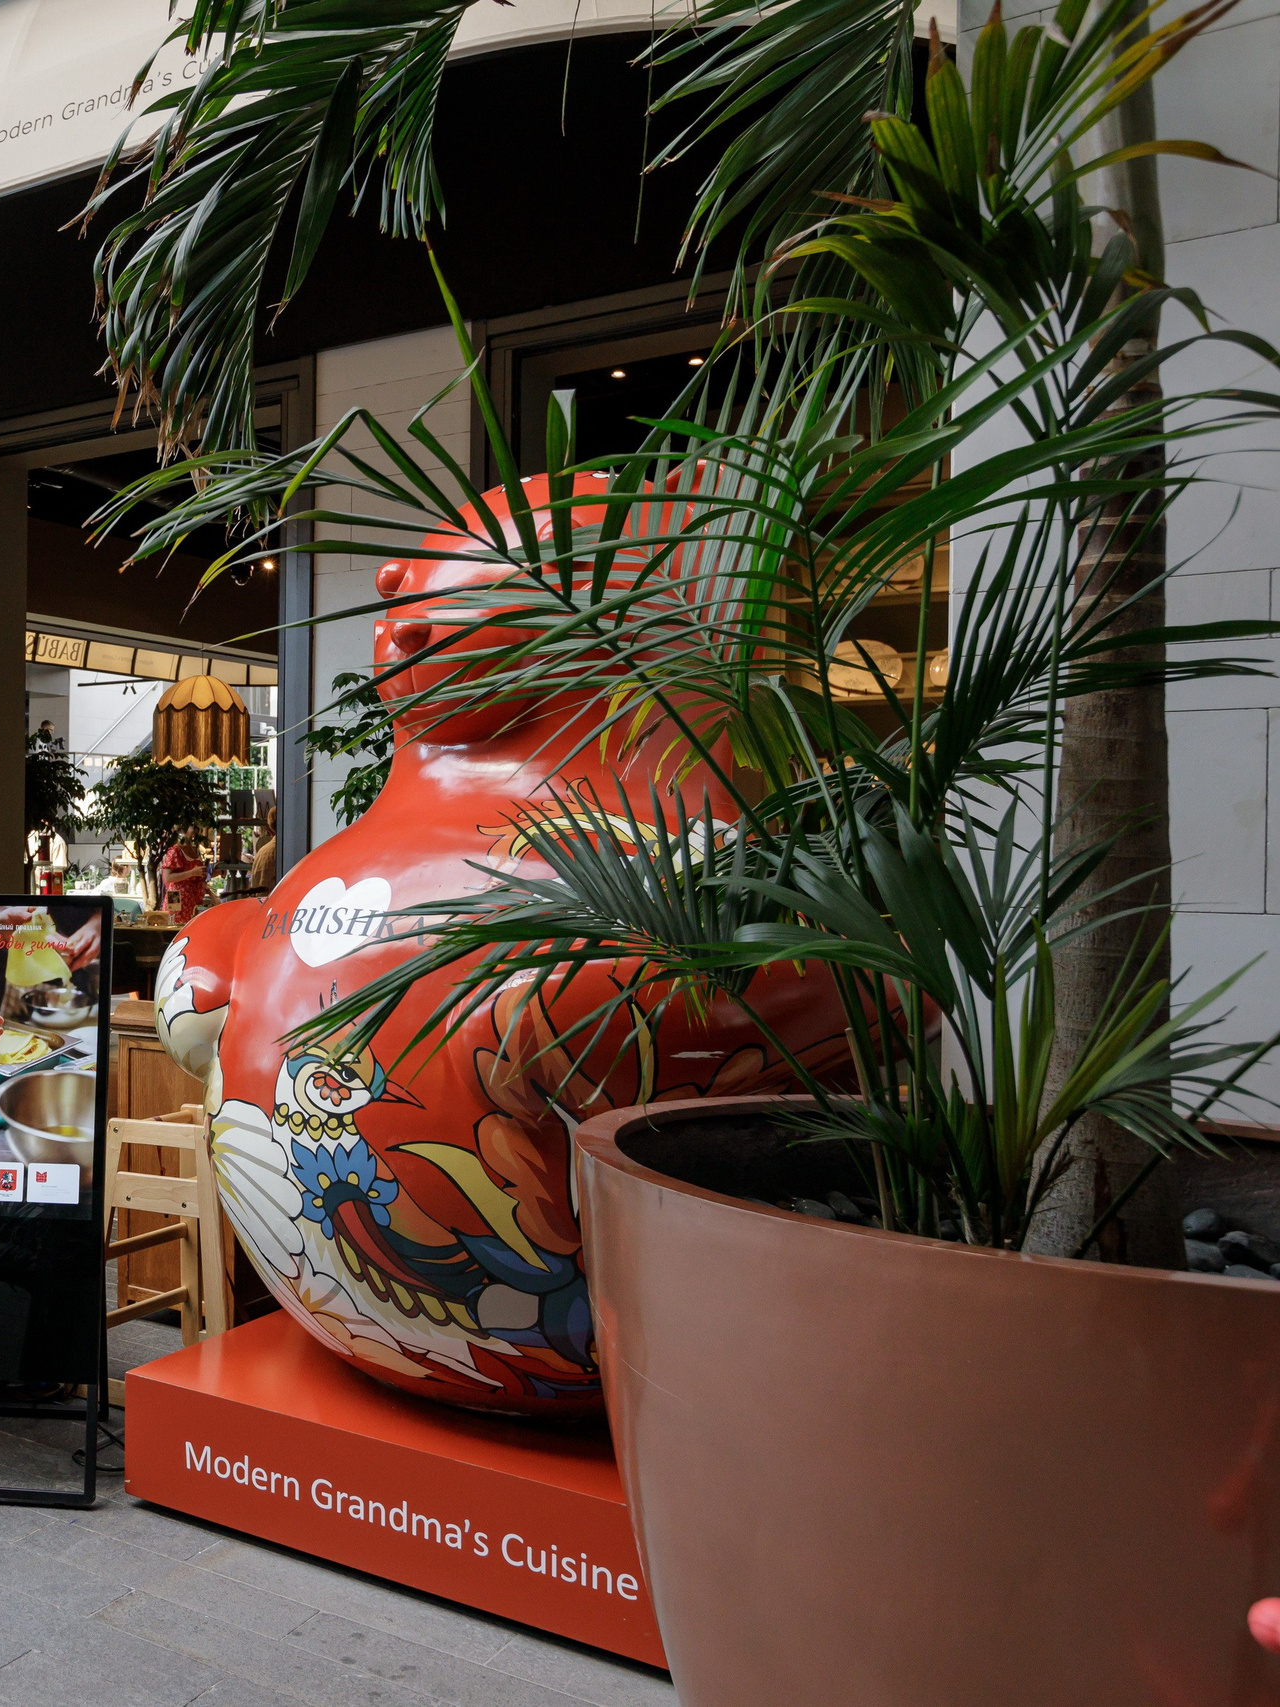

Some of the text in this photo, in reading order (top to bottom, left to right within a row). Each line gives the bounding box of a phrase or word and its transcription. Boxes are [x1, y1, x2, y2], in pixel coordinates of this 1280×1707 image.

[25, 939, 68, 956] зимы
[184, 1441, 640, 1601] Modern Grandma's Cuisine
